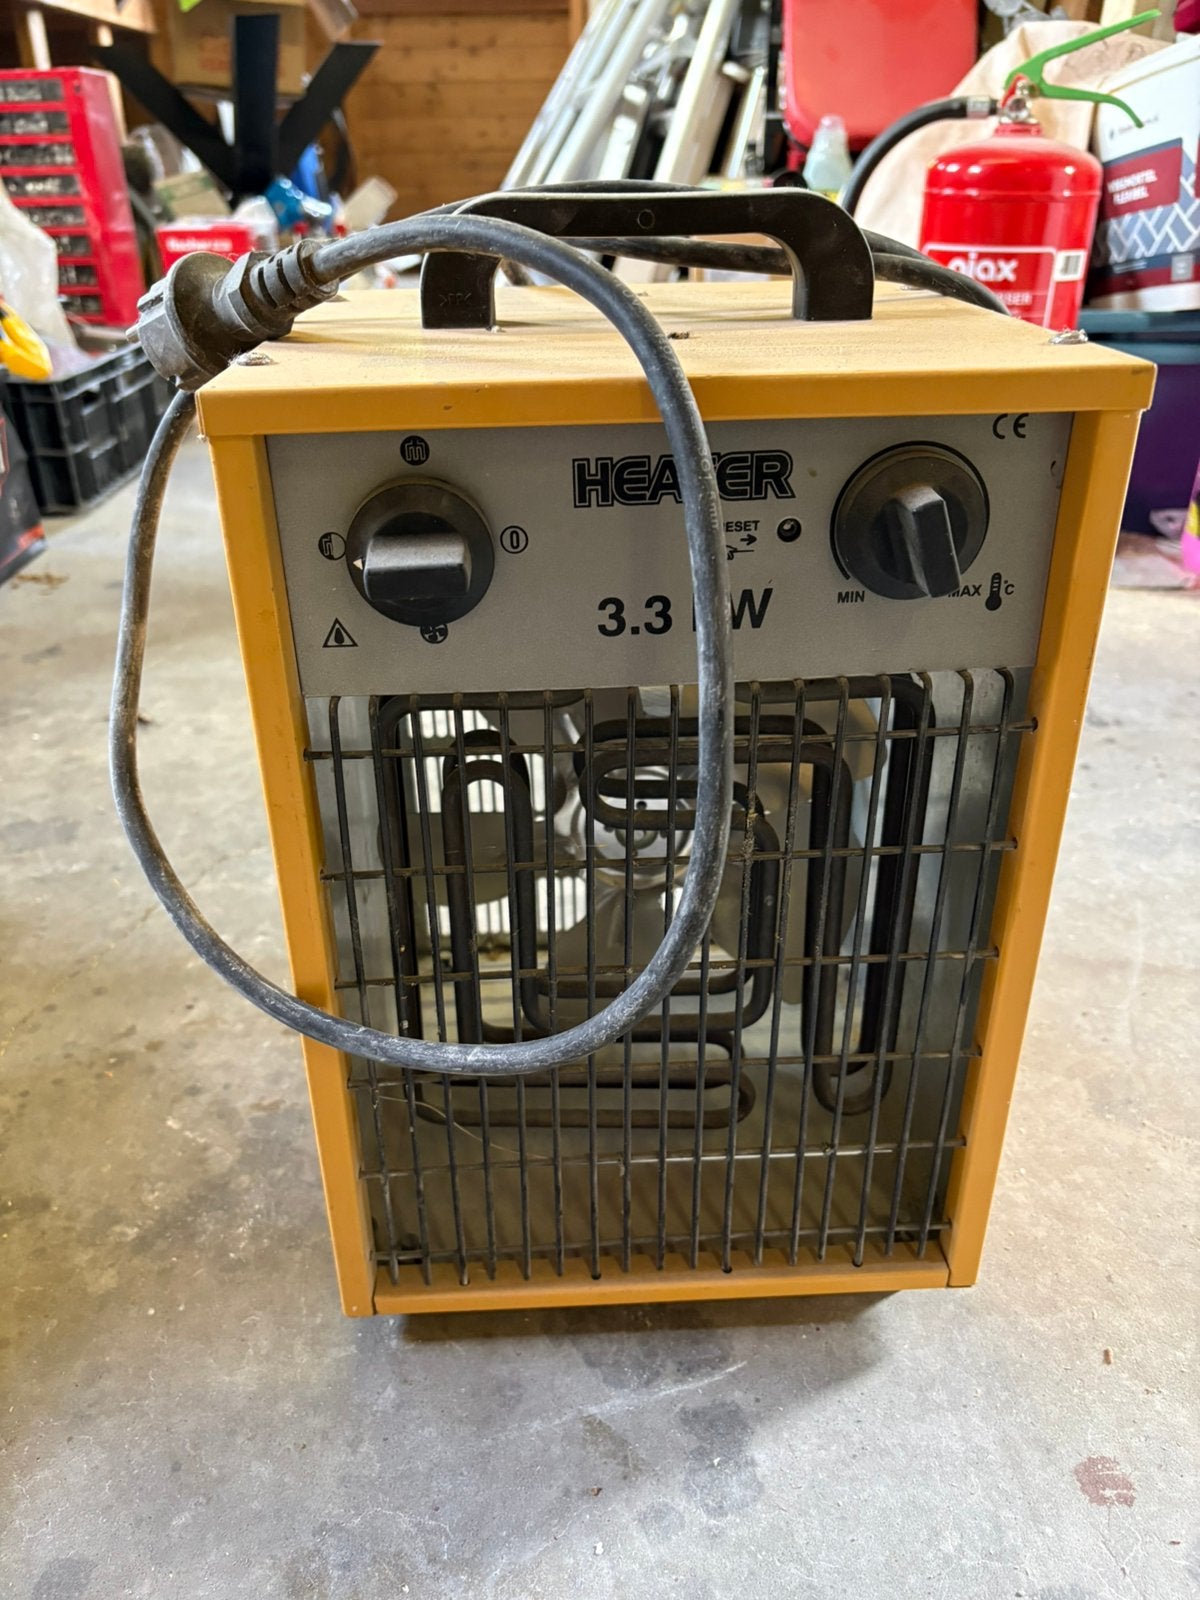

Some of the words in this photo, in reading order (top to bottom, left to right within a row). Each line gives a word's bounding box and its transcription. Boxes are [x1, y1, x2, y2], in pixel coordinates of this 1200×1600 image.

[947, 251, 1019, 282] ajax
[992, 412, 1030, 440] CE
[572, 449, 796, 509] HEAER
[724, 519, 761, 533] ESET
[836, 590, 865, 604] MIN
[597, 594, 673, 637] 3.3
[692, 587, 774, 632] W
